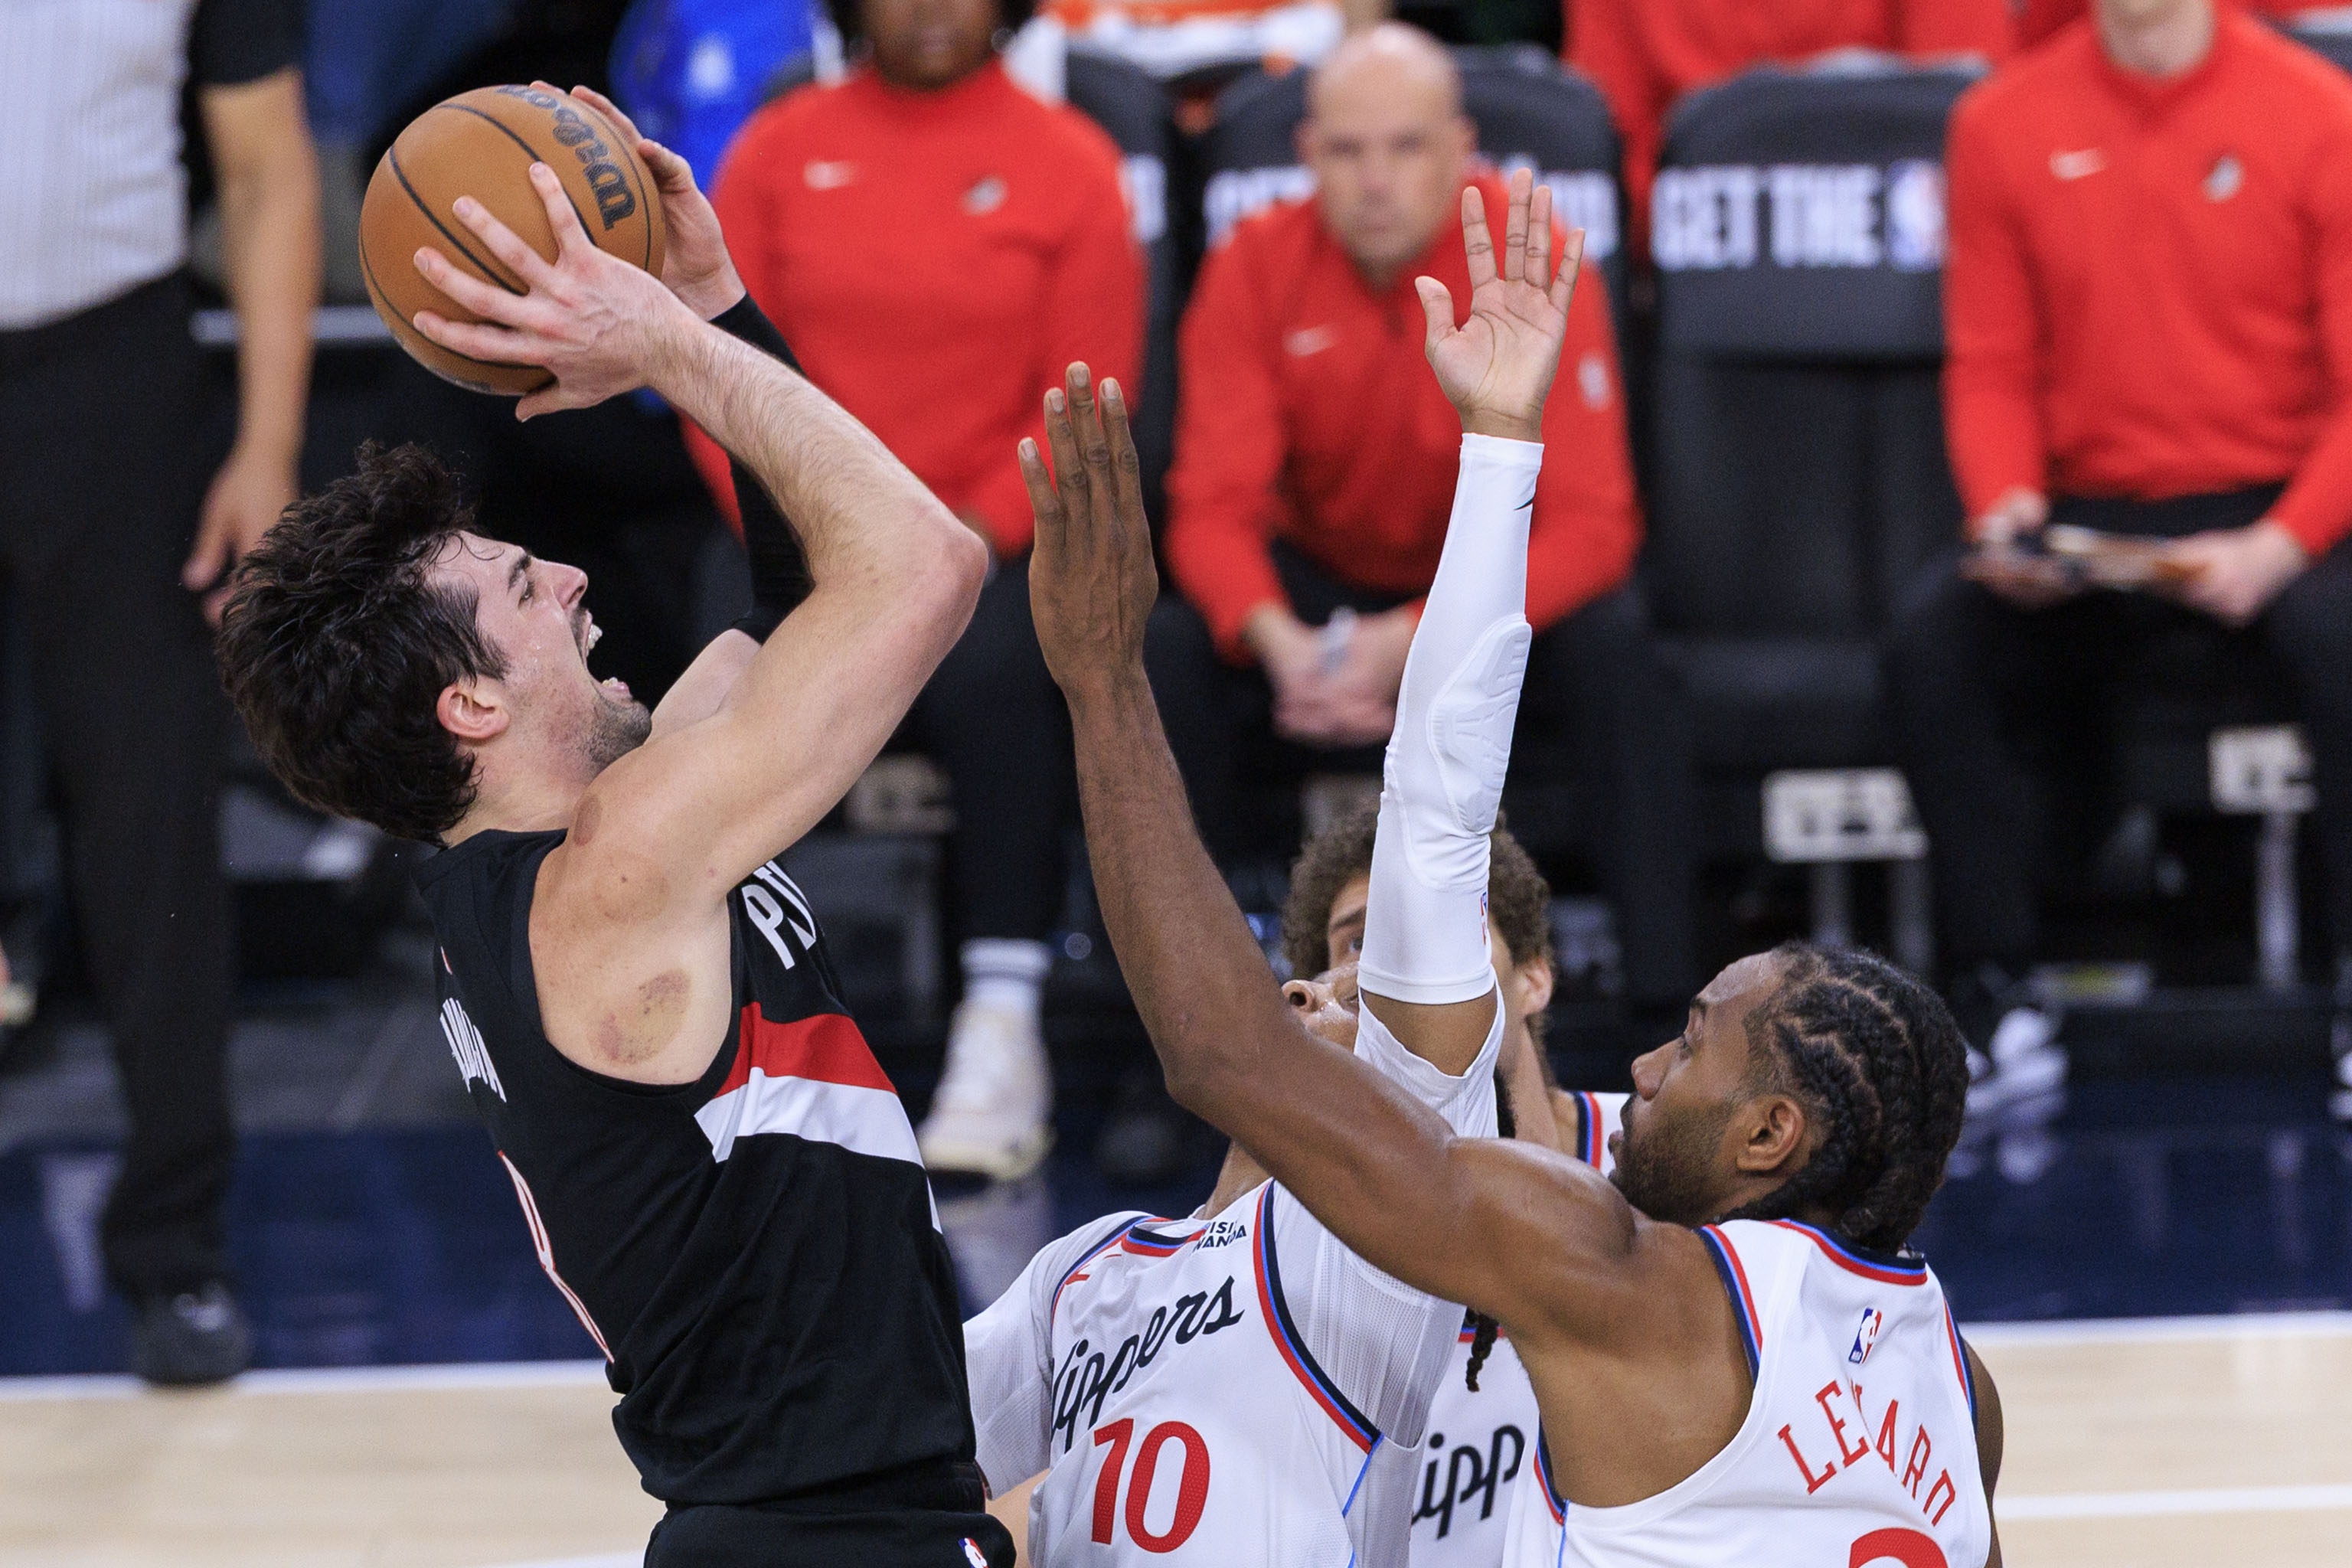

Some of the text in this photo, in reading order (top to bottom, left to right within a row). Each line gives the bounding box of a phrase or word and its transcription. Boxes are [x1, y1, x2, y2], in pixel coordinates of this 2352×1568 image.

[1651, 165, 1758, 269] GET
[1769, 165, 1882, 268] THE
[1209, 1220, 1237, 1233] ISI
[1091, 1418, 1210, 1553] 10
